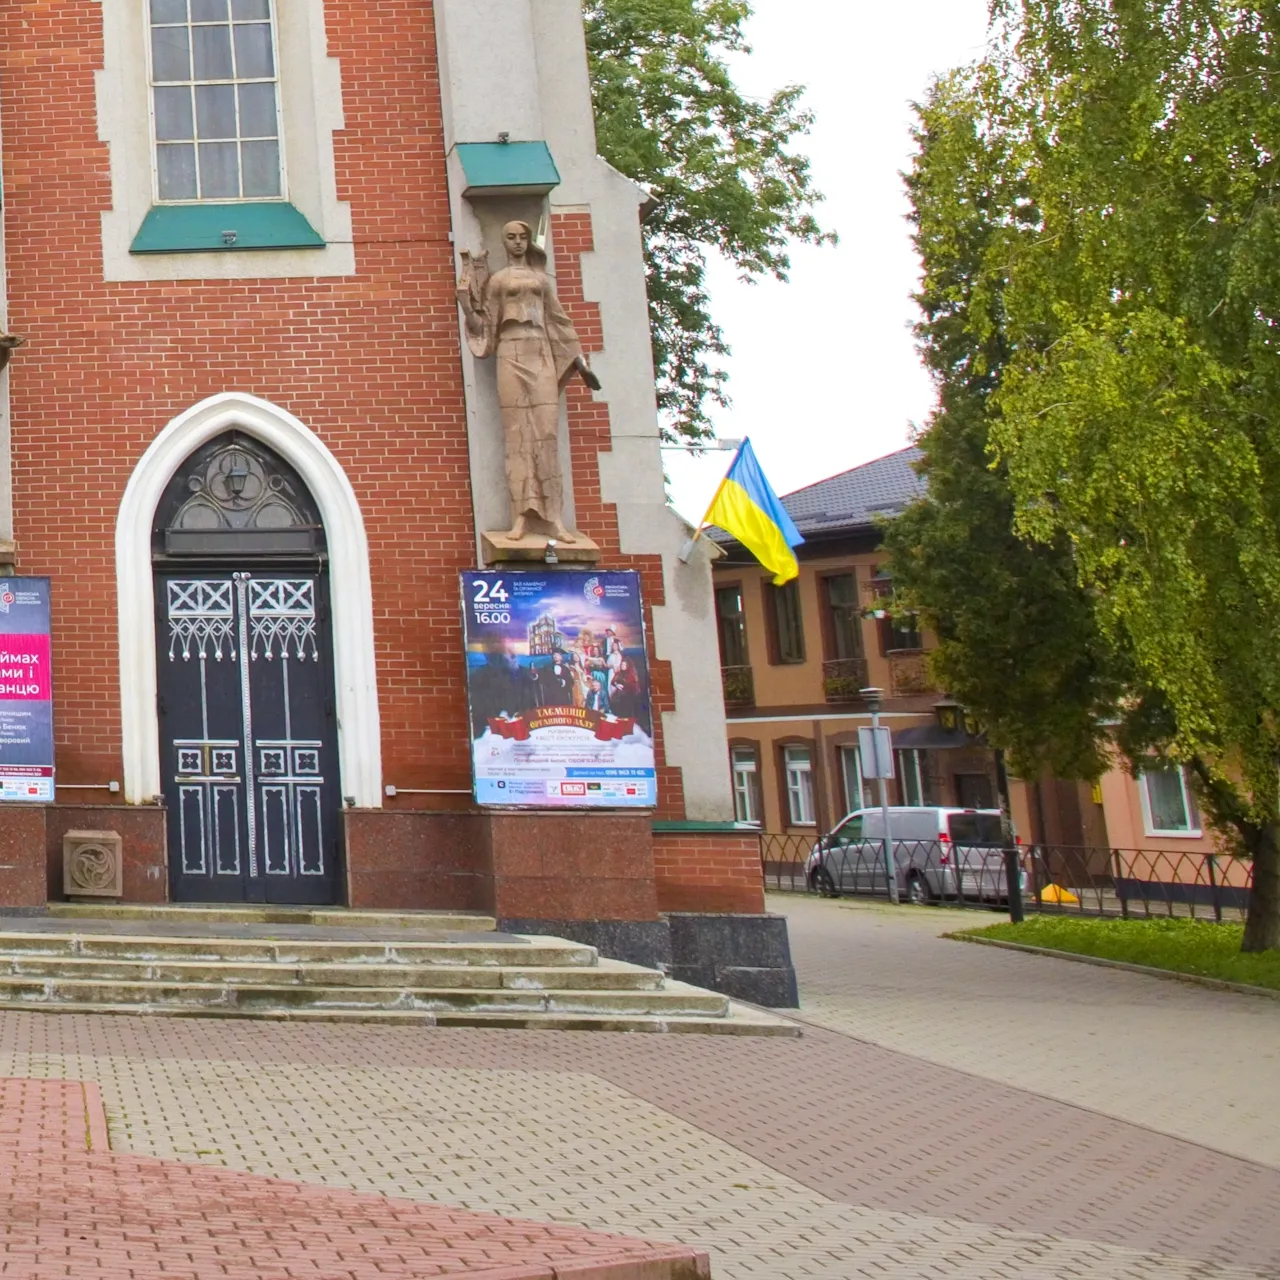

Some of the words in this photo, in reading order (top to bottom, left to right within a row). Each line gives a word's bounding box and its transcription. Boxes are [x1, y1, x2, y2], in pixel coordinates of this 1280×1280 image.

[472, 580, 509, 602] 24
[475, 612, 510, 624] 16.00
[29, 666, 34, 679] і
